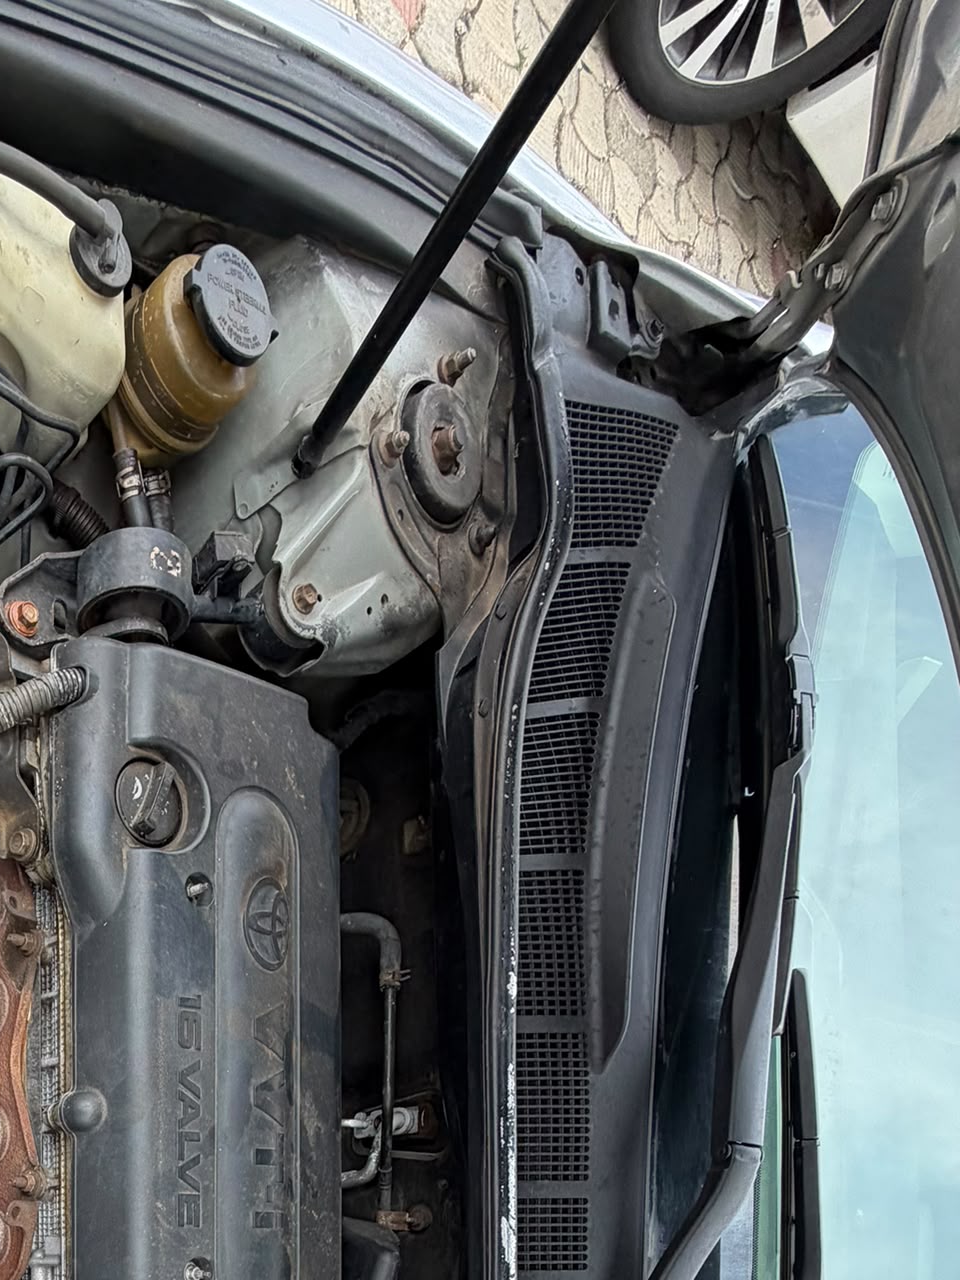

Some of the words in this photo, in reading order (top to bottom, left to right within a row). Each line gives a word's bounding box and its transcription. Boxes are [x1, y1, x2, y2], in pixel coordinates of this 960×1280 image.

[176, 995, 202, 1051] 16
[176, 1059, 202, 1228] VALVE
[252, 1002, 285, 1229] VVT-i
